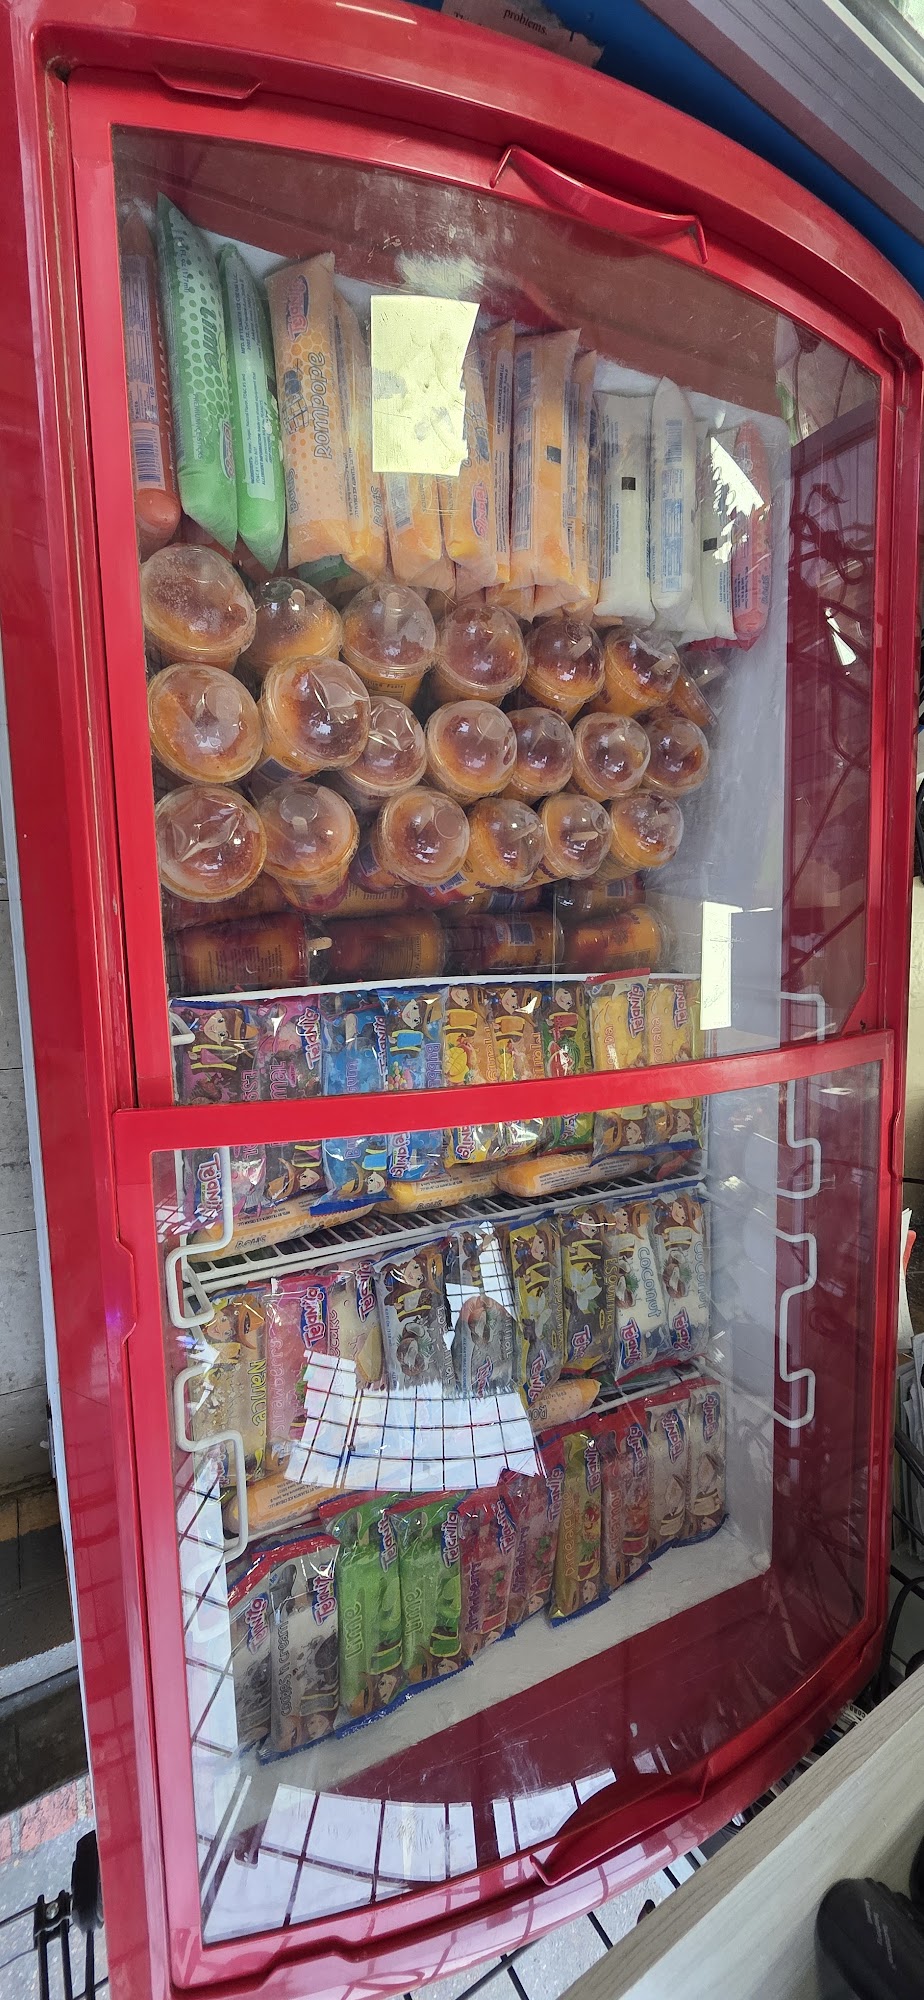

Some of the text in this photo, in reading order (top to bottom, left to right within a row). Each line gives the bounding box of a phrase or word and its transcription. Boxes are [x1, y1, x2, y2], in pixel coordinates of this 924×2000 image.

[504, 9, 548, 36] problems.
[627, 983, 646, 1039] Tejanita
[301, 1286, 327, 1347] Tejanita
[620, 1318, 643, 1366] Tejanita
[248, 1359, 267, 1426] Nance
[269, 1338, 287, 1433] Strawberry
[661, 1411, 685, 1464] Tejanita
[702, 1395, 718, 1443] Tejanita
[626, 1426, 648, 1478] Tejanita
[546, 1467, 564, 1523] Tejanita
[441, 1511, 460, 1568] Tejanita
[496, 1499, 517, 1556] Tejanita
[245, 1597, 269, 1653] Tejanita
[344, 1601, 365, 1660] Lime
[404, 1587, 423, 1637] Lime
